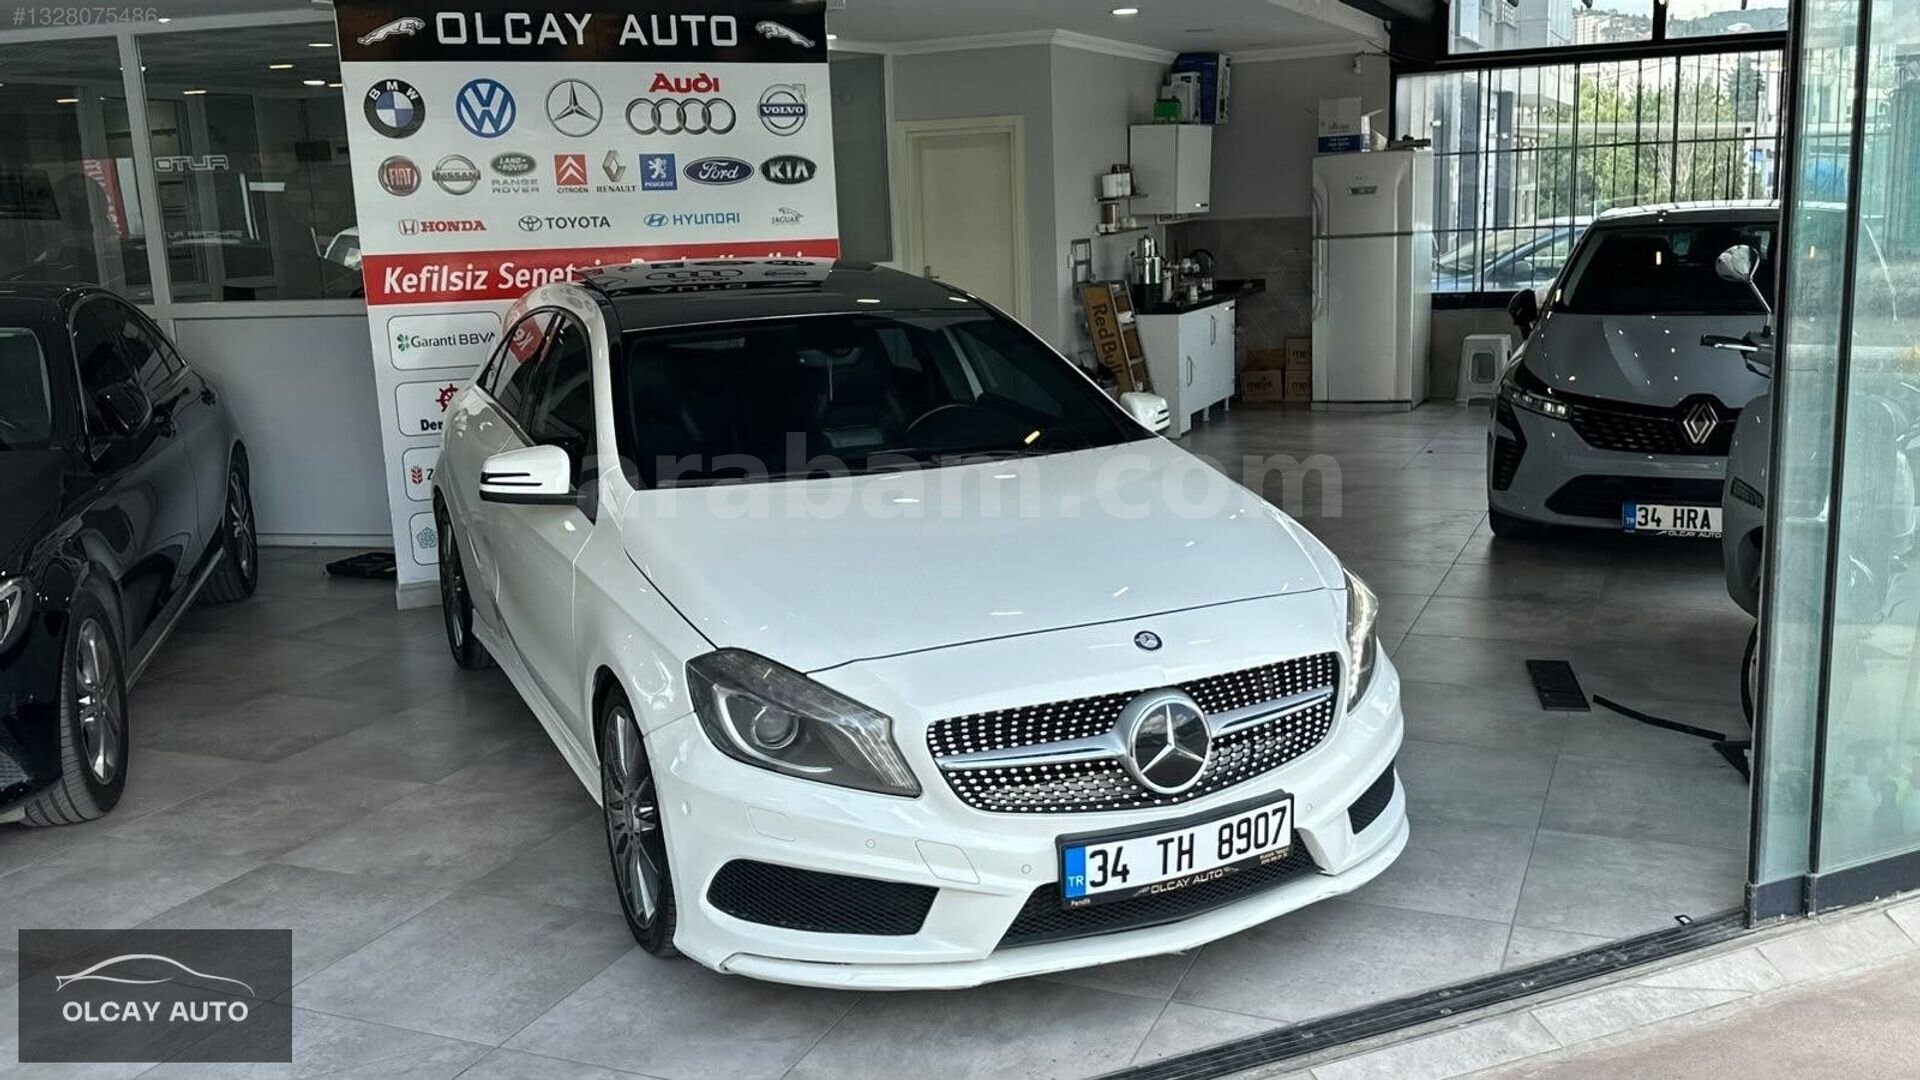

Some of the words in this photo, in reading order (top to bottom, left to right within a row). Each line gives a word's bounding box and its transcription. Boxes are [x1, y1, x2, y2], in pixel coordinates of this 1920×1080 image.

[436, 12, 592, 45] OLCAY
[619, 14, 738, 47] AUTO
[369, 80, 420, 101] BMW
[649, 73, 720, 93] Audi
[762, 105, 804, 115] VOLVO
[388, 168, 413, 186] FIAT
[435, 170, 478, 181] NISSAN
[698, 162, 740, 181] Ford
[769, 161, 810, 179] KIA
[491, 178, 539, 187] RANGE
[596, 185, 637, 193] RENAULT
[420, 219, 487, 233] HONDA
[545, 216, 611, 230] TOYOTA
[673, 212, 741, 226] HYUNDAI
[383, 263, 489, 294] Kefilsiz
[411, 335, 457, 348] Garanti
[1637, 506, 1662, 528] 34
[1673, 508, 1711, 530] HRA
[1698, 531, 1722, 539] AUTO
[1089, 846, 1130, 888] 34
[1157, 833, 1194, 876] TH
[1217, 805, 1287, 861] 8907
[1068, 875, 1084, 887] TR
[1151, 878, 1190, 894] OLCAY
[1192, 867, 1223, 885] AUTO
